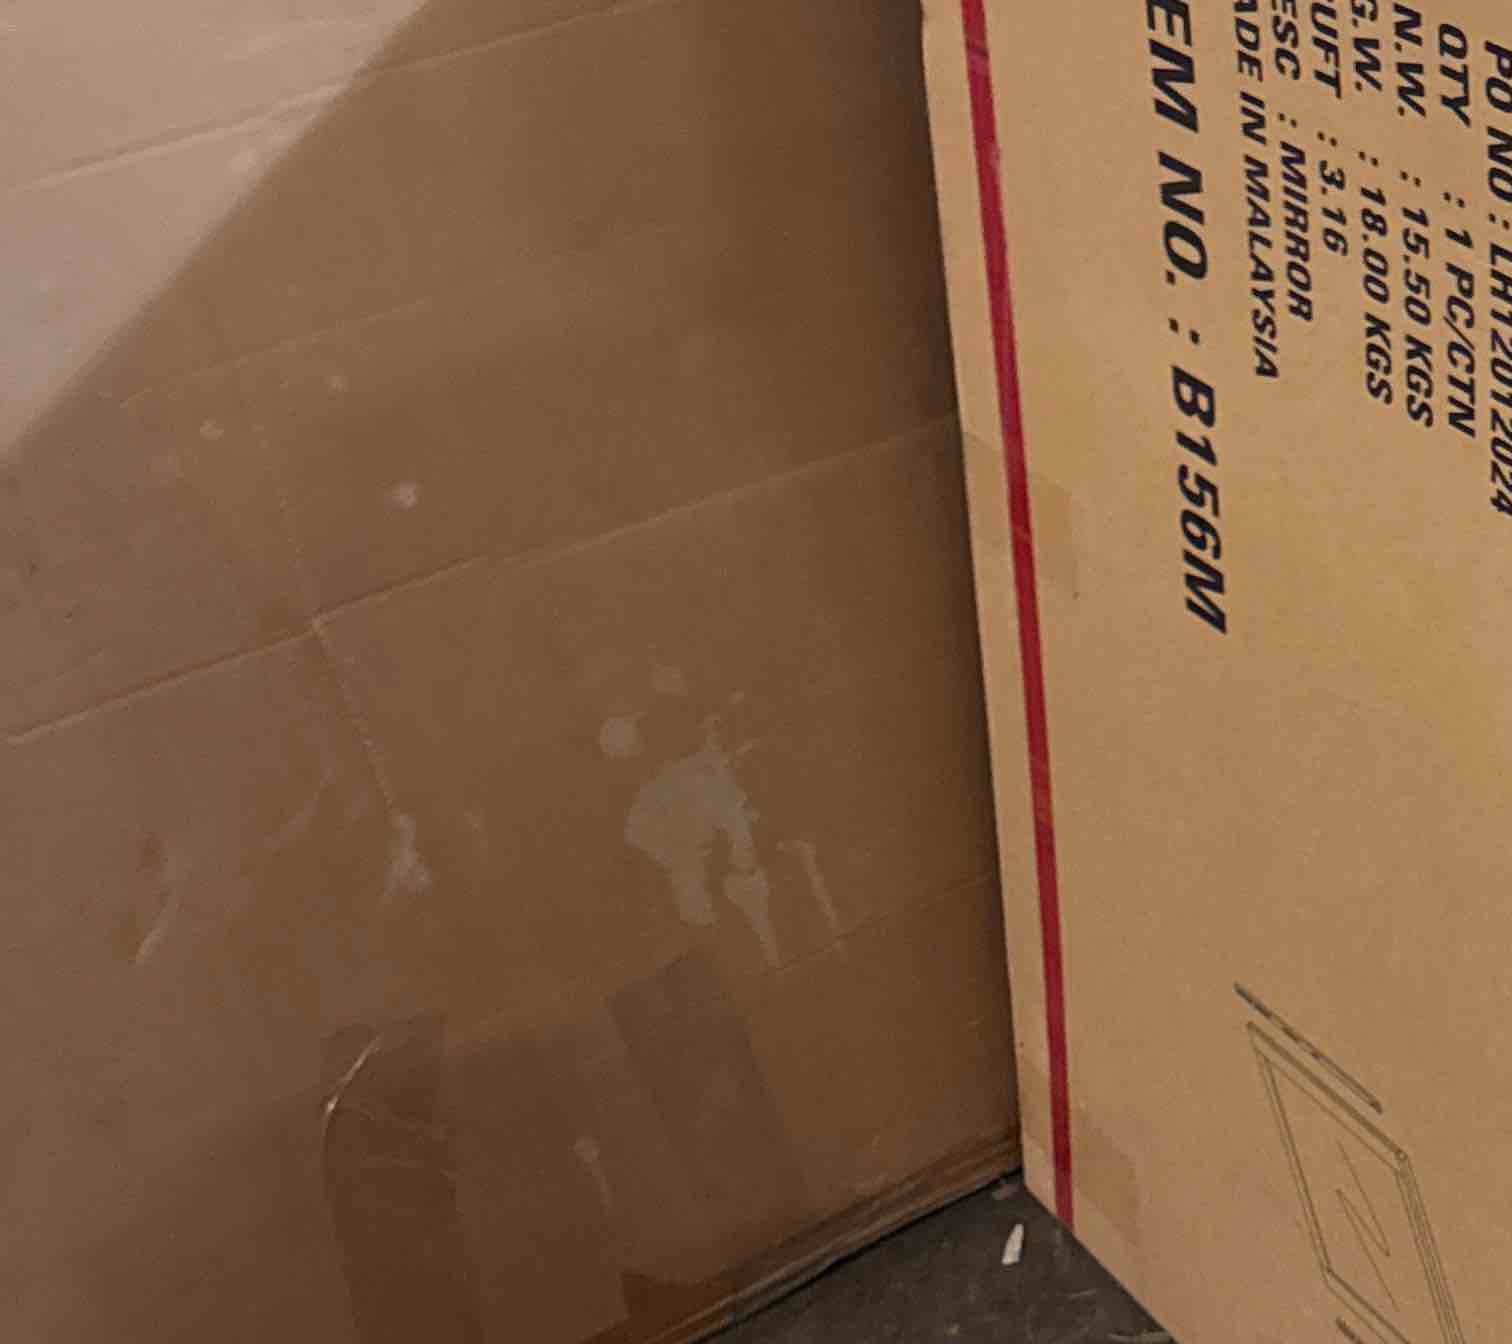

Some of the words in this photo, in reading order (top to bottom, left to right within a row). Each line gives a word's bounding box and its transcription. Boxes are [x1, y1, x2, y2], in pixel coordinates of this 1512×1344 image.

[1393, 2, 1426, 117] N.W.
[1438, 23, 1471, 127] QTY
[1239, 91, 1267, 145] IN
[1157, 151, 1208, 285] NO.
[1244, 154, 1278, 378] MALAYSIA
[1279, 141, 1313, 322] MIRROR
[1319, 159, 1348, 257] 3.16
[1360, 187, 1390, 304] 18.00
[1445, 228, 1473, 249] 1
[1402, 207, 1431, 326] 15.50
[1364, 311, 1393, 405] KGS
[1405, 334, 1434, 428] KGS
[1443, 262, 1476, 438] PC/CTN
[1171, 365, 1227, 635] B156M
